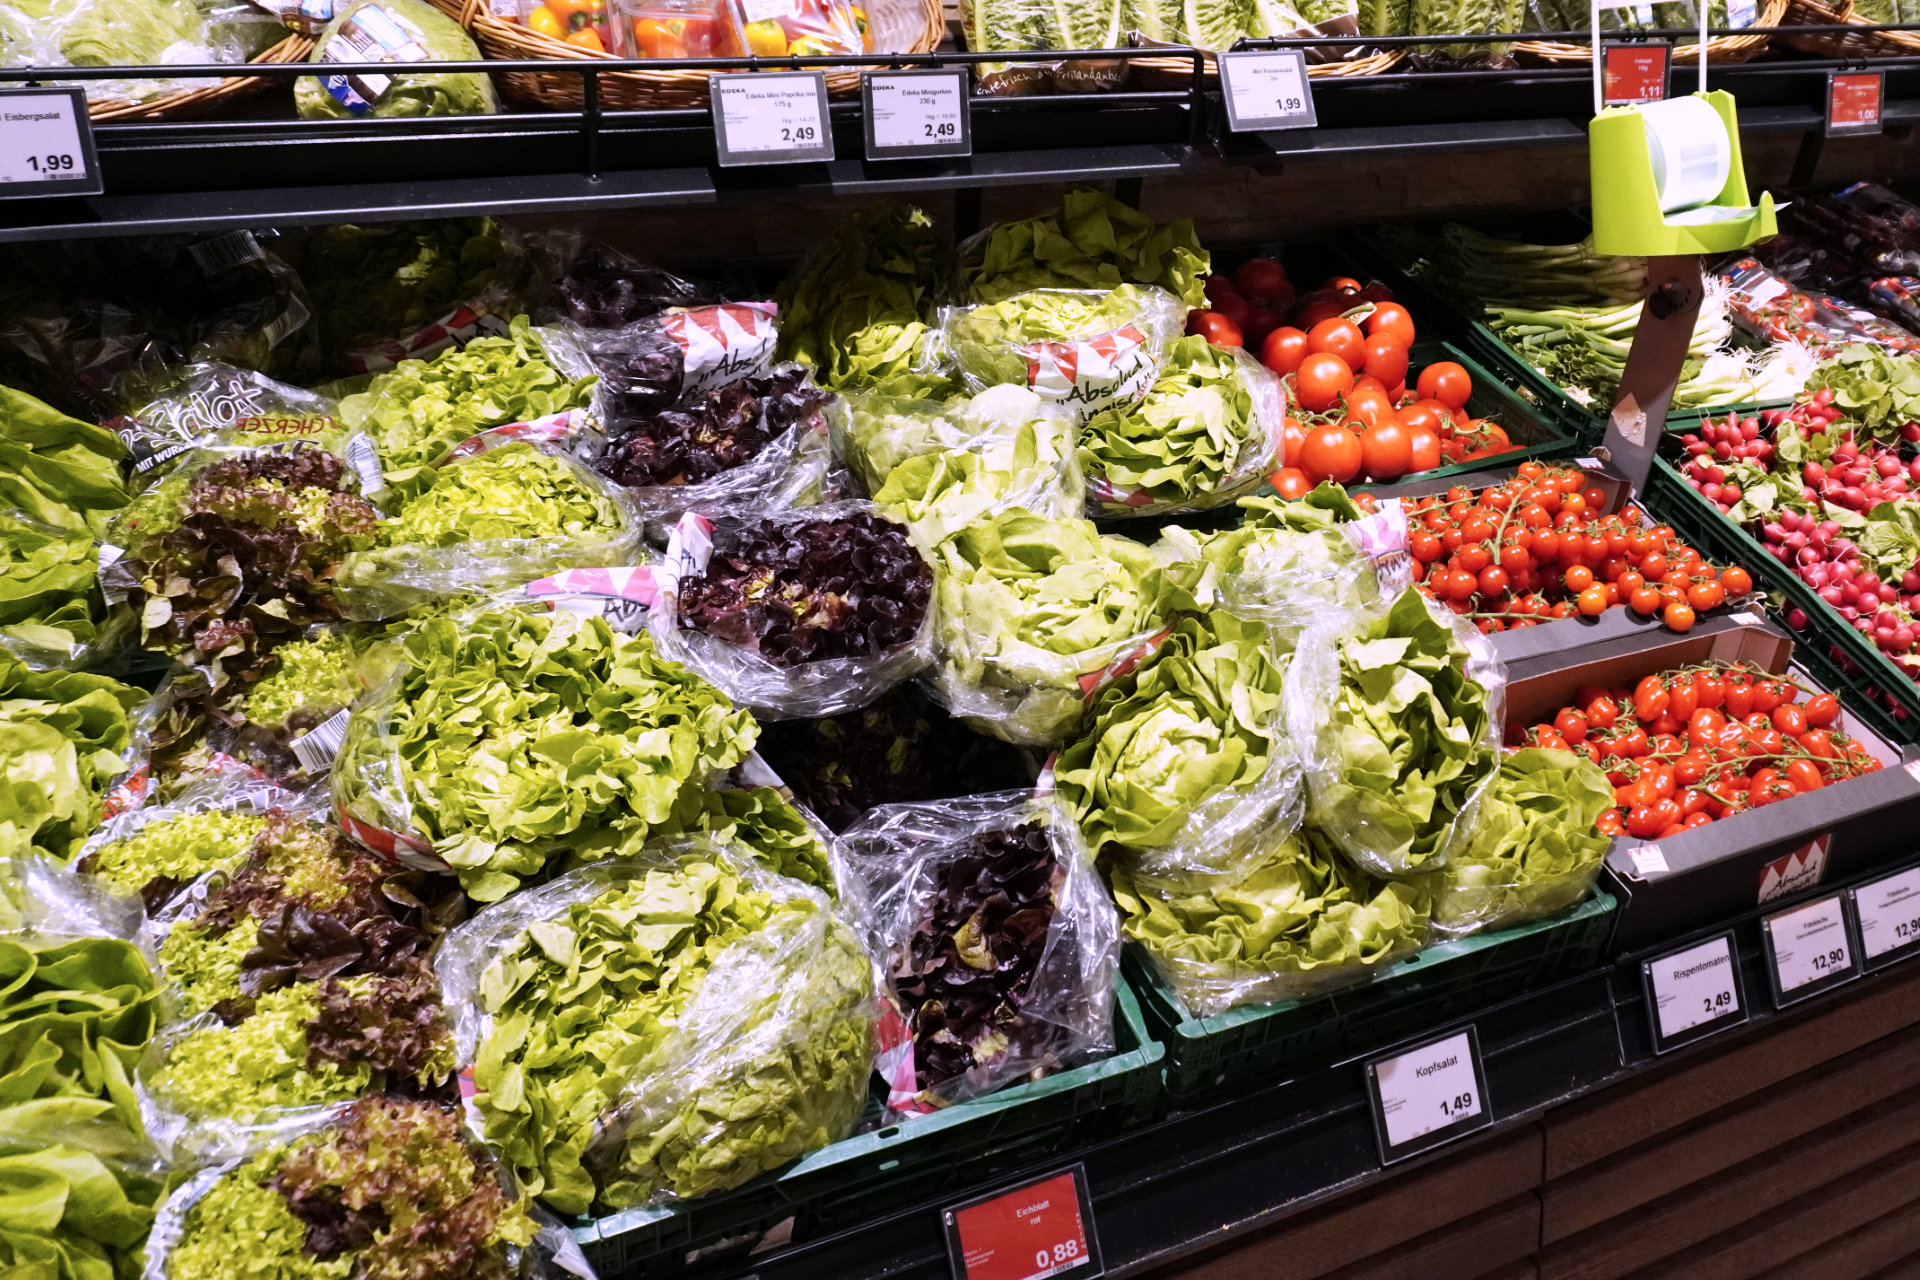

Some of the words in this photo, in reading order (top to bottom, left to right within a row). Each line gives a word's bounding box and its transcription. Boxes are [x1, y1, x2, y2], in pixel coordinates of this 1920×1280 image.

[745, 92, 766, 100] Edeka
[780, 90, 805, 100] Paprika
[1275, 98, 1301, 112] 1,99
[4, 112, 61, 122] Eisbergsalat
[781, 127, 815, 143] 2,49
[924, 123, 955, 139] 2,49
[26, 154, 74, 174] 1,99
[136, 456, 155, 473] MIT
[1673, 954, 1730, 981] Rispentomaten
[1811, 948, 1845, 970] 12,90
[1703, 991, 1731, 1013] 2,49
[1415, 1055, 1458, 1078] Kopfsalat
[1440, 1092, 1472, 1116] 1,49
[1016, 1200, 1050, 1218] Eichblatt
[1030, 1215, 1041, 1225] rot
[1035, 1239, 1079, 1268] 0,88
